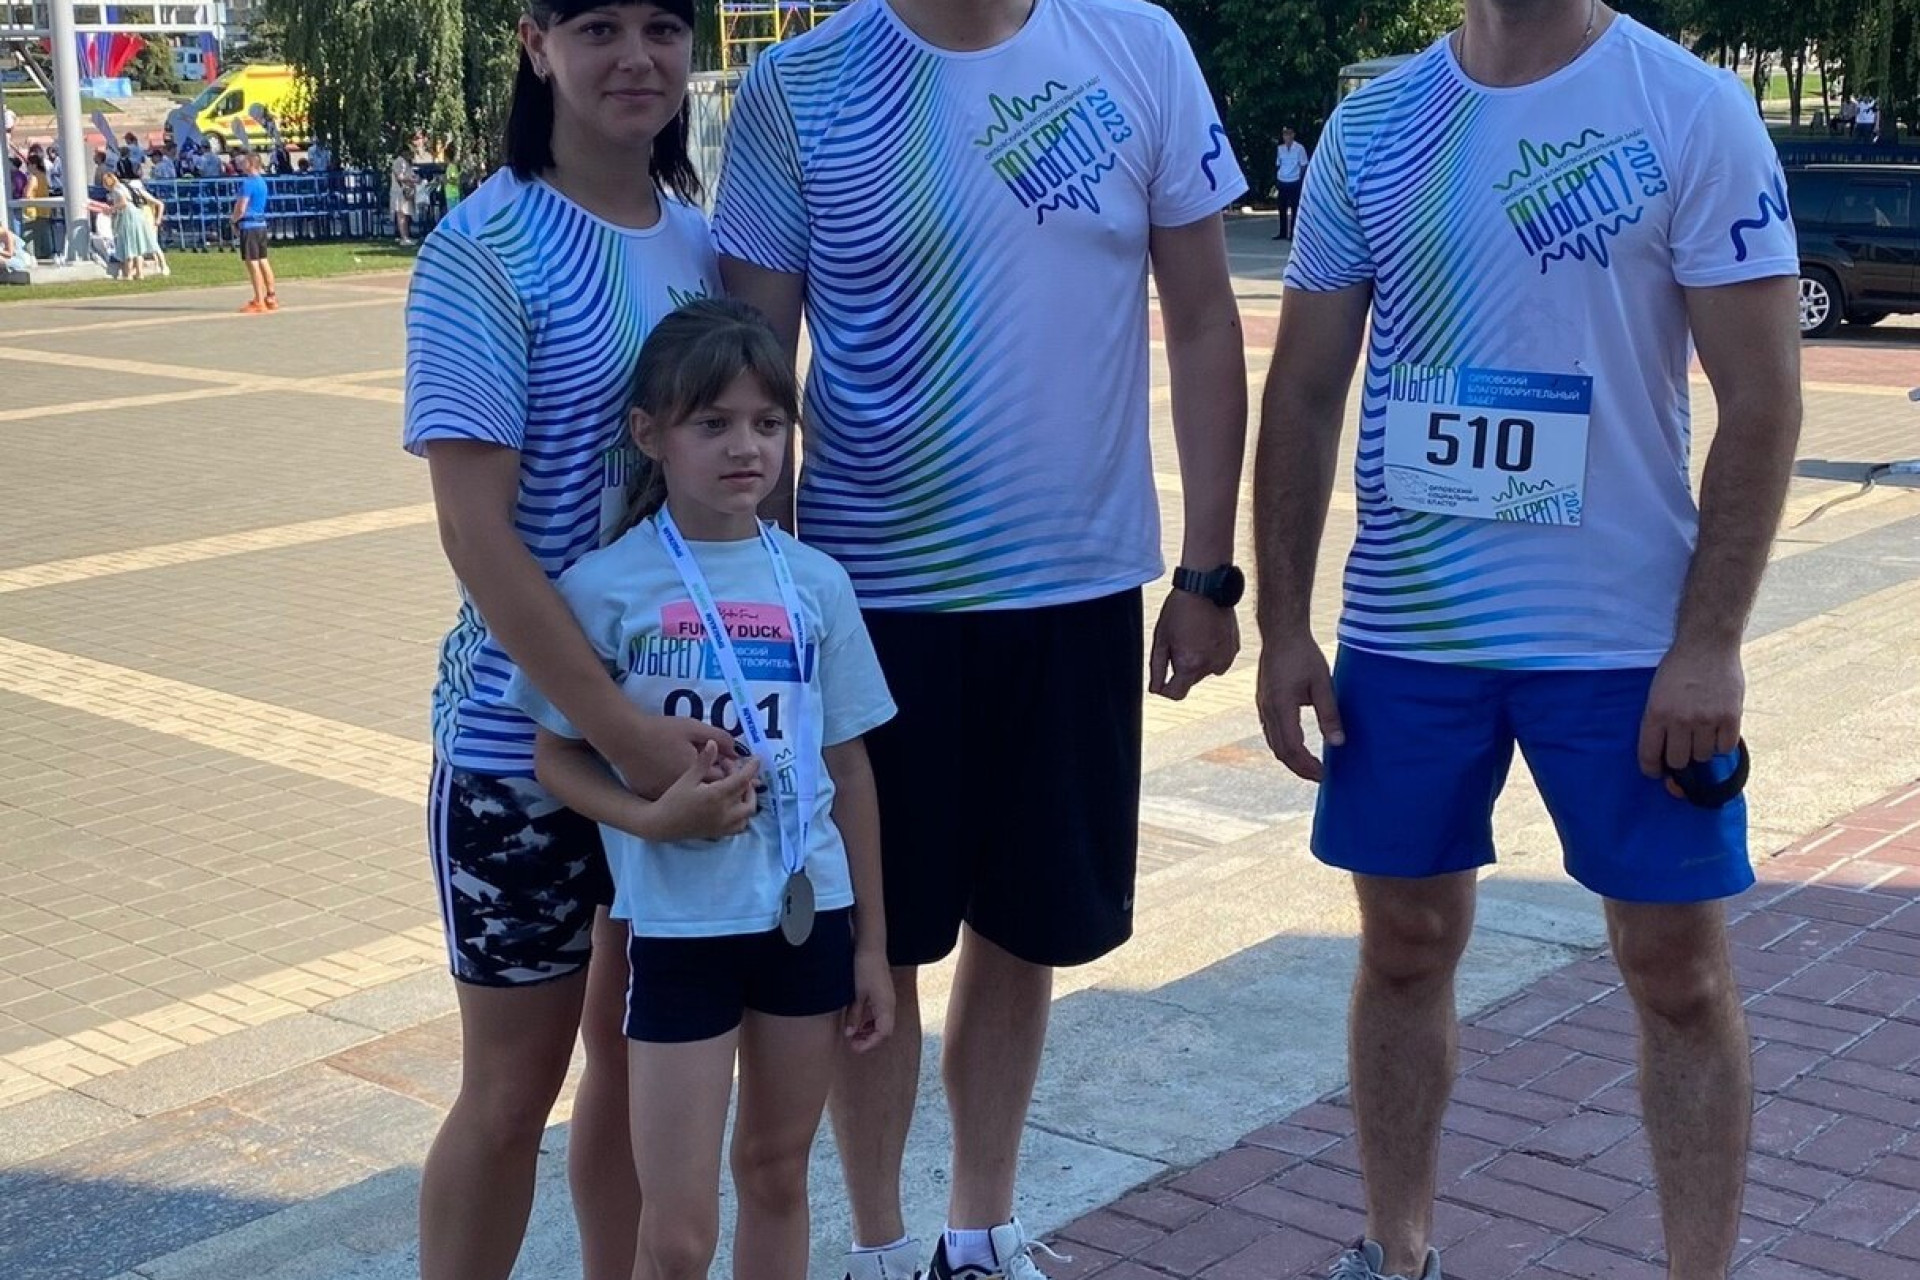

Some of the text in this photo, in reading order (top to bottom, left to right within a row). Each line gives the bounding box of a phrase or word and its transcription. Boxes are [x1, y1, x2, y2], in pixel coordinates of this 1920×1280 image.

[1085, 88, 1133, 144] 2023
[1622, 140, 1668, 197] 2023
[1467, 384, 1580, 400] БЛАГОТВОРИТЕЛЬНЫЙ
[1468, 373, 1528, 385] ОРЛОВСКИЙ
[1426, 411, 1535, 472] 510
[737, 624, 783, 639] DUCK
